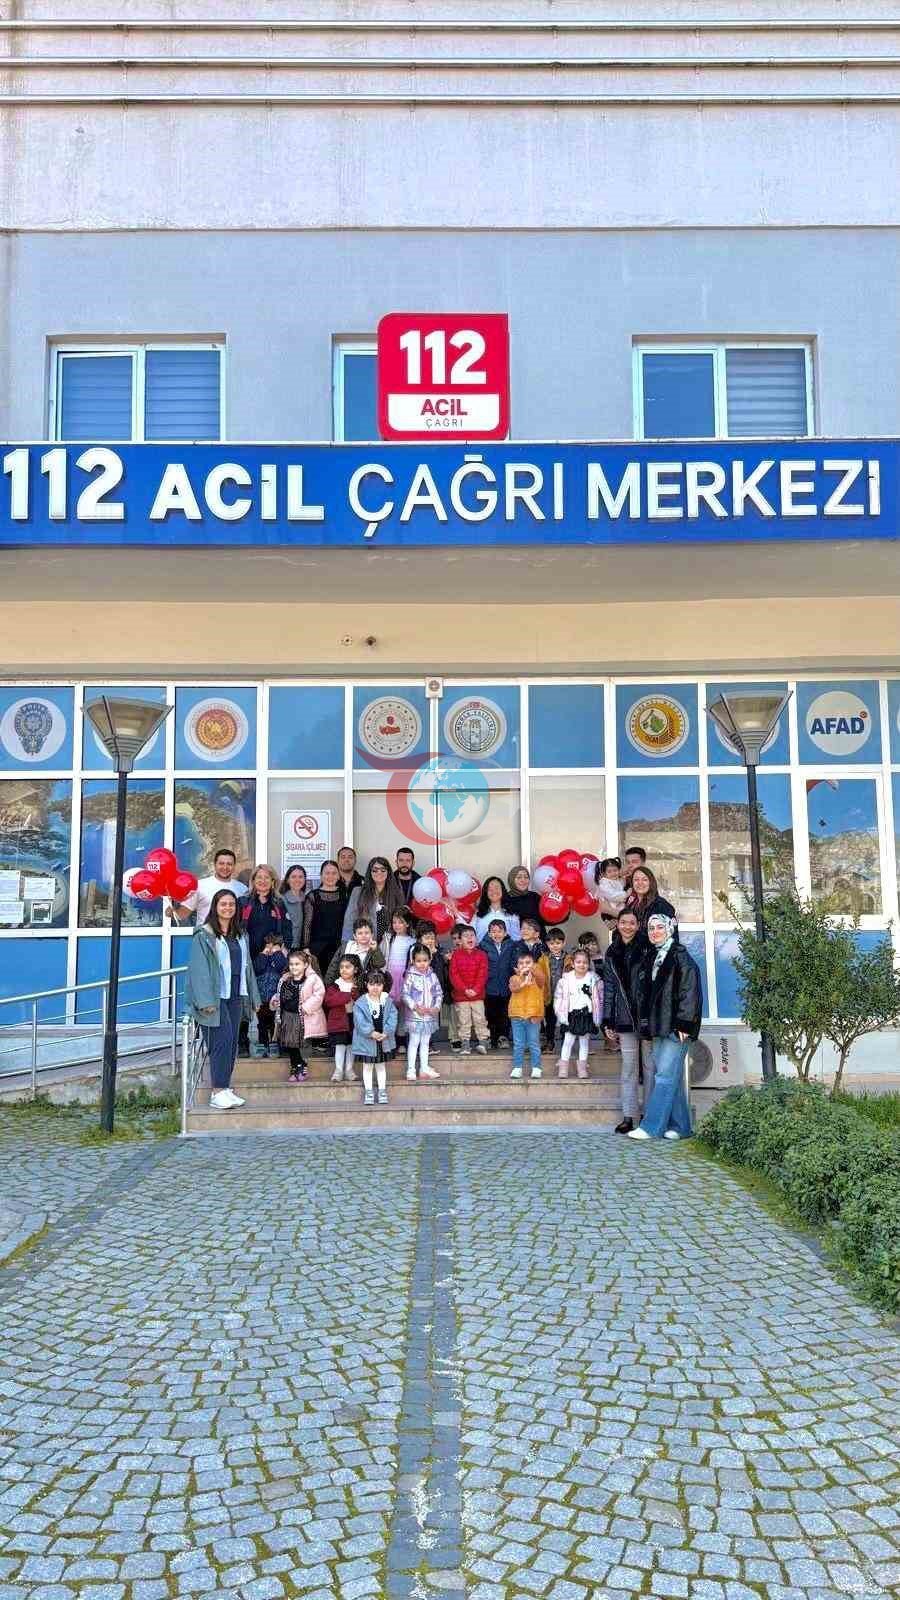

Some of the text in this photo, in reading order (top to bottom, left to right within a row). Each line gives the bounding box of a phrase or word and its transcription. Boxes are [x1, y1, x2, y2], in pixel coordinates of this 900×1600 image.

[400, 329, 487, 385] 112
[420, 398, 468, 416] ACİL
[426, 417, 463, 429] ÇAĞRI
[3, 447, 881, 537] 112 ACİL ÇAĞRI MERKEZİ
[810, 717, 865, 735] AFAD
